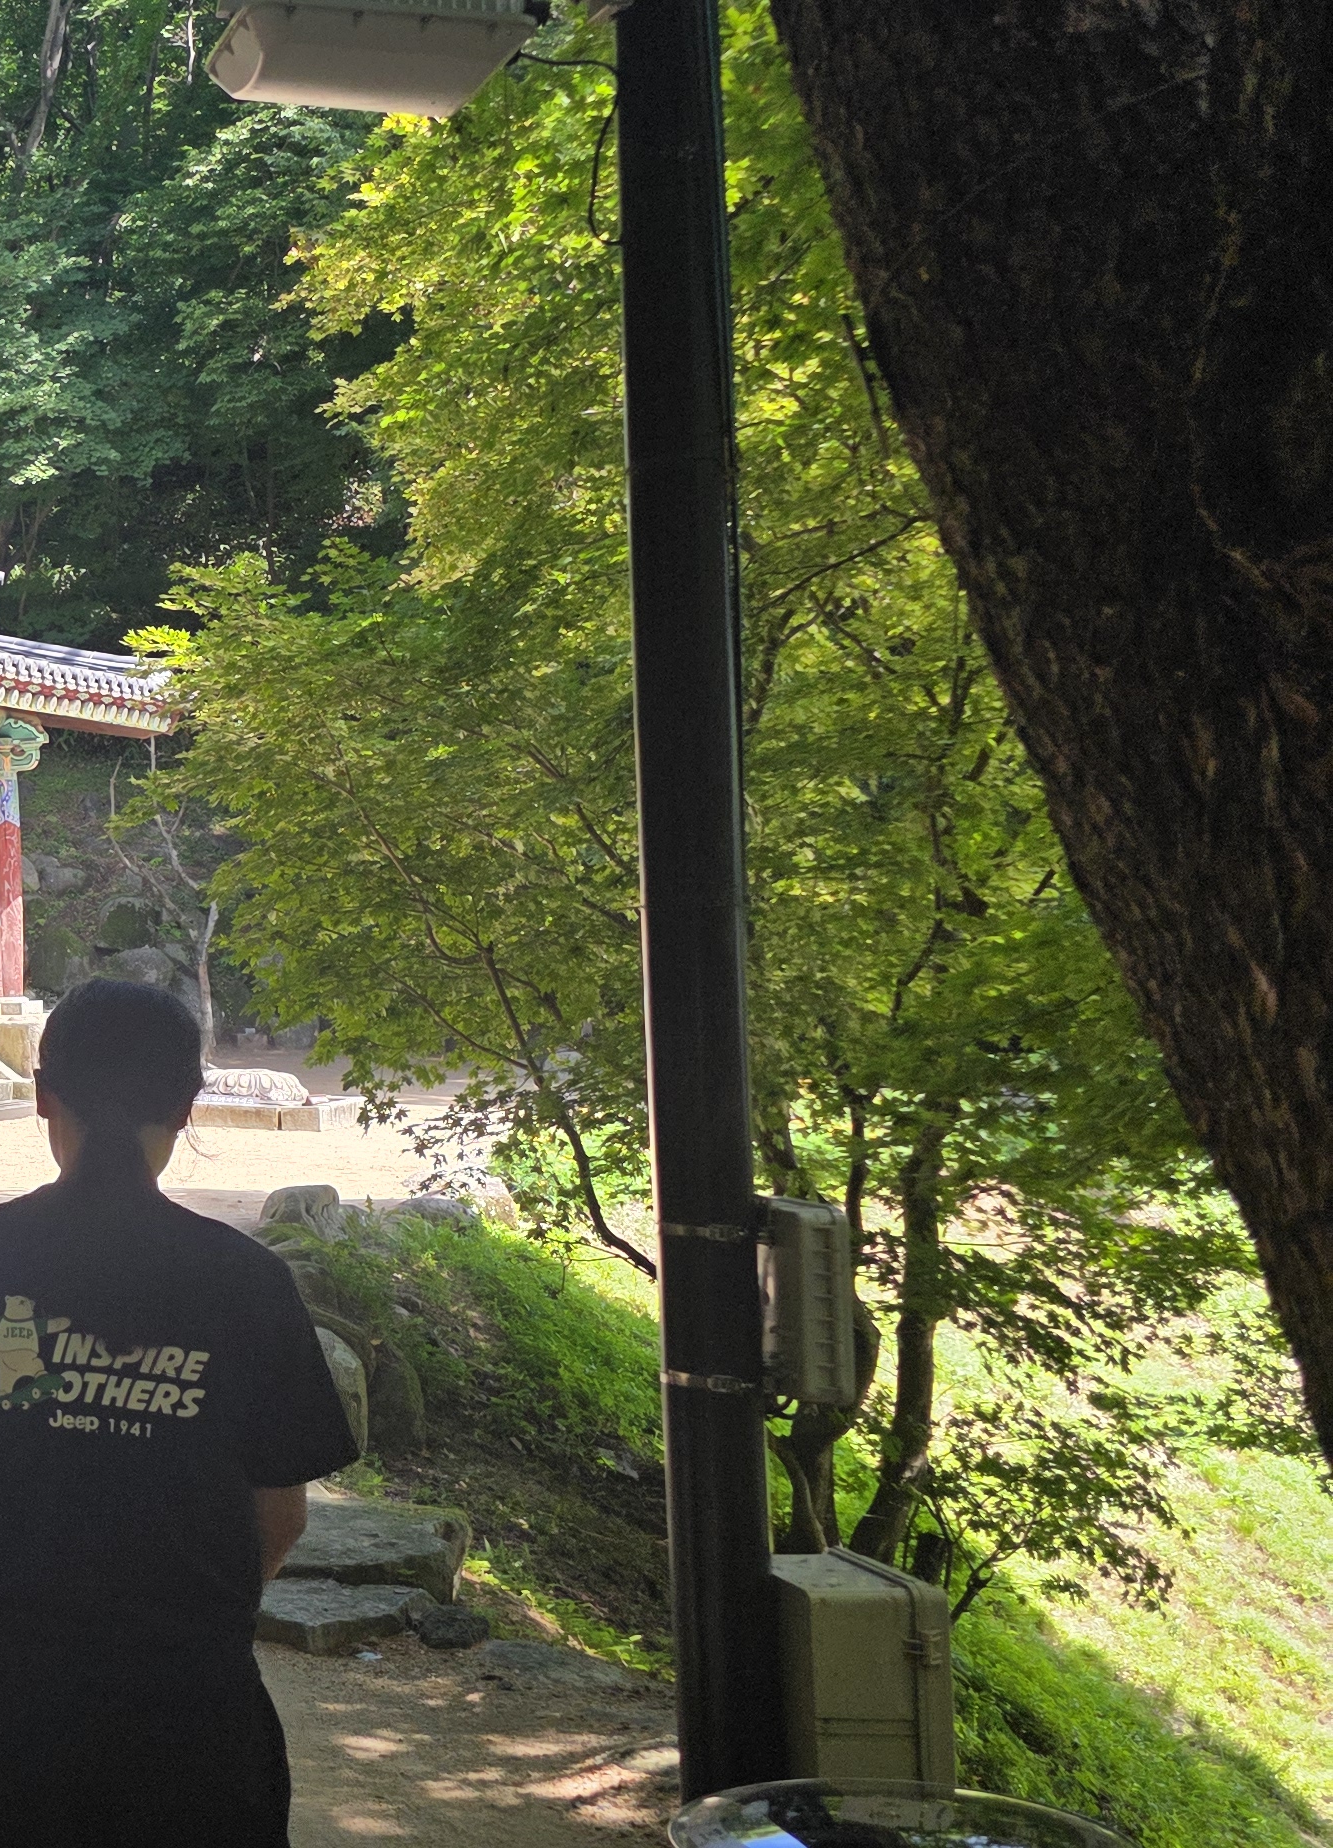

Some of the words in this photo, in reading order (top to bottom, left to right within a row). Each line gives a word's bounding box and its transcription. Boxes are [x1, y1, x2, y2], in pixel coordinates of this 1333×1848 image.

[3, 1326, 34, 1340] JEEP
[52, 1332, 211, 1381] INSPIRE
[57, 1370, 206, 1418] OTHERS
[48, 1409, 100, 1433] Jeep
[108, 1418, 153, 1439] 1941
